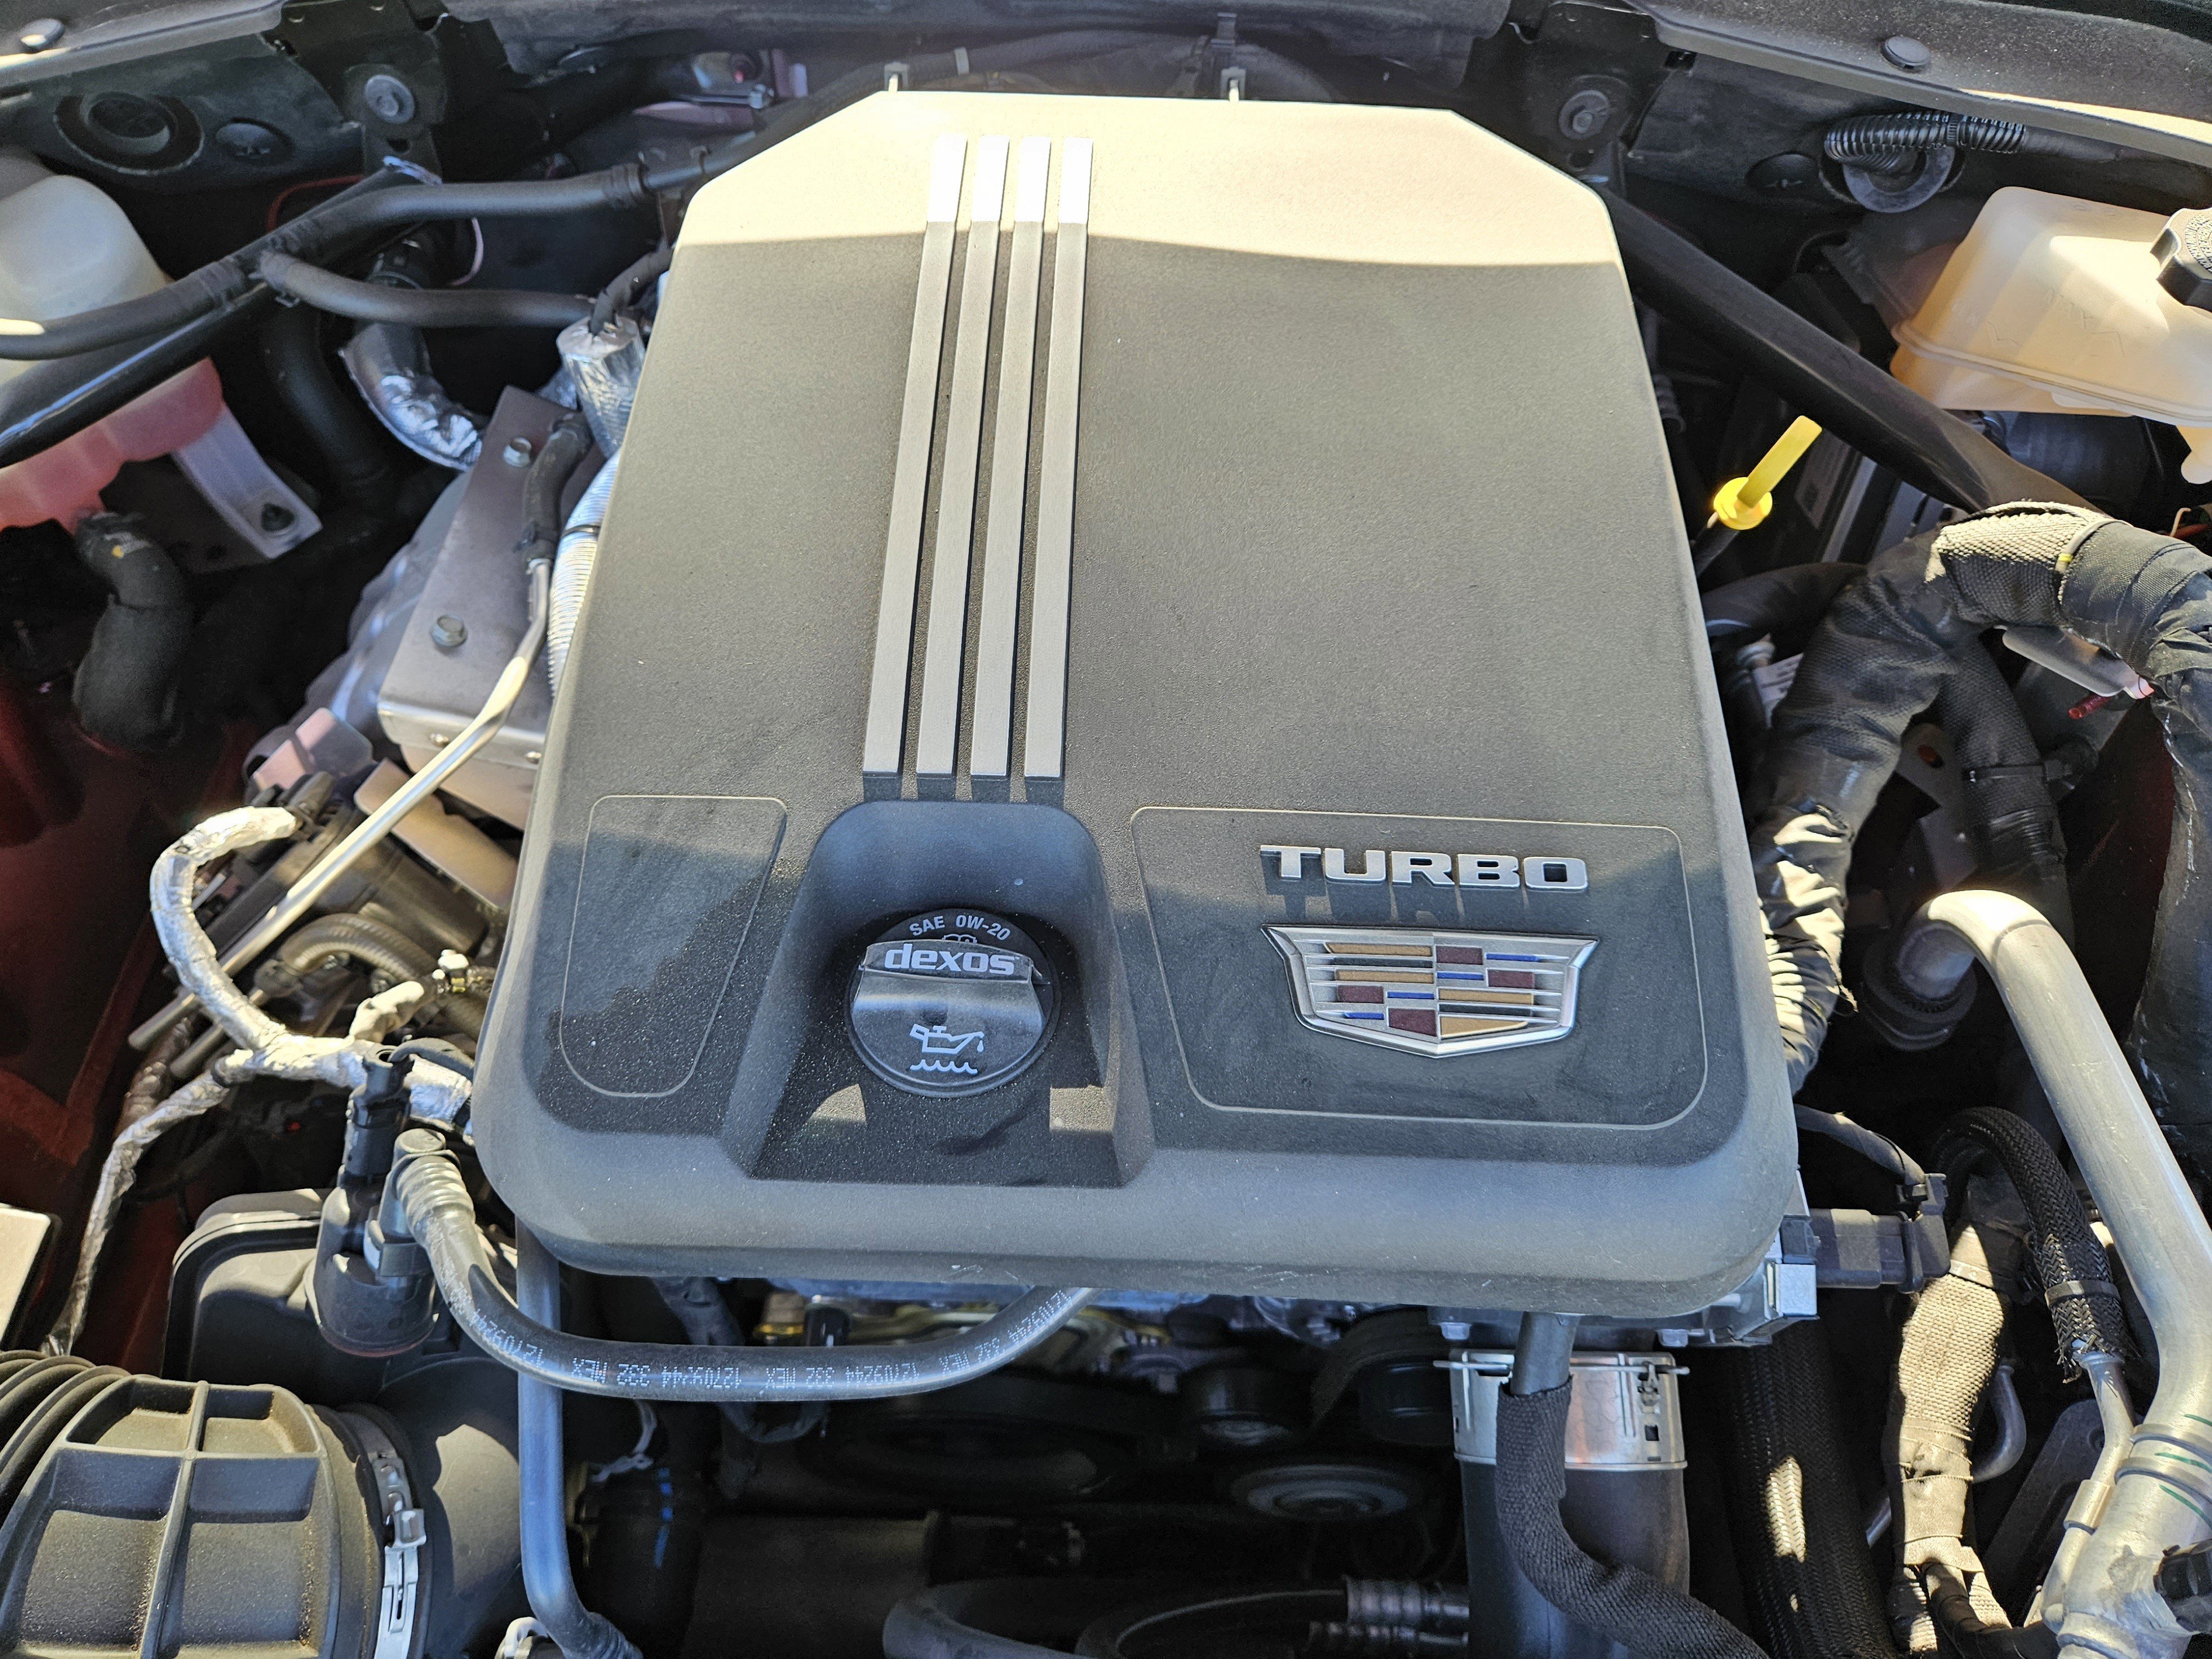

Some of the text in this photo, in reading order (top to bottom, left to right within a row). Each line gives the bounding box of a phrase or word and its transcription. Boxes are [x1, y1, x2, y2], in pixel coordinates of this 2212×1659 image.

[1260, 844, 1588, 891] TURBO
[909, 915, 1011, 940] SAE 0W-20
[885, 943, 1015, 975] dexos
[572, 1357, 608, 1384] MEX
[617, 1363, 651, 1387] 332
[765, 1366, 796, 1389] MEX
[805, 1367, 835, 1388] 332
